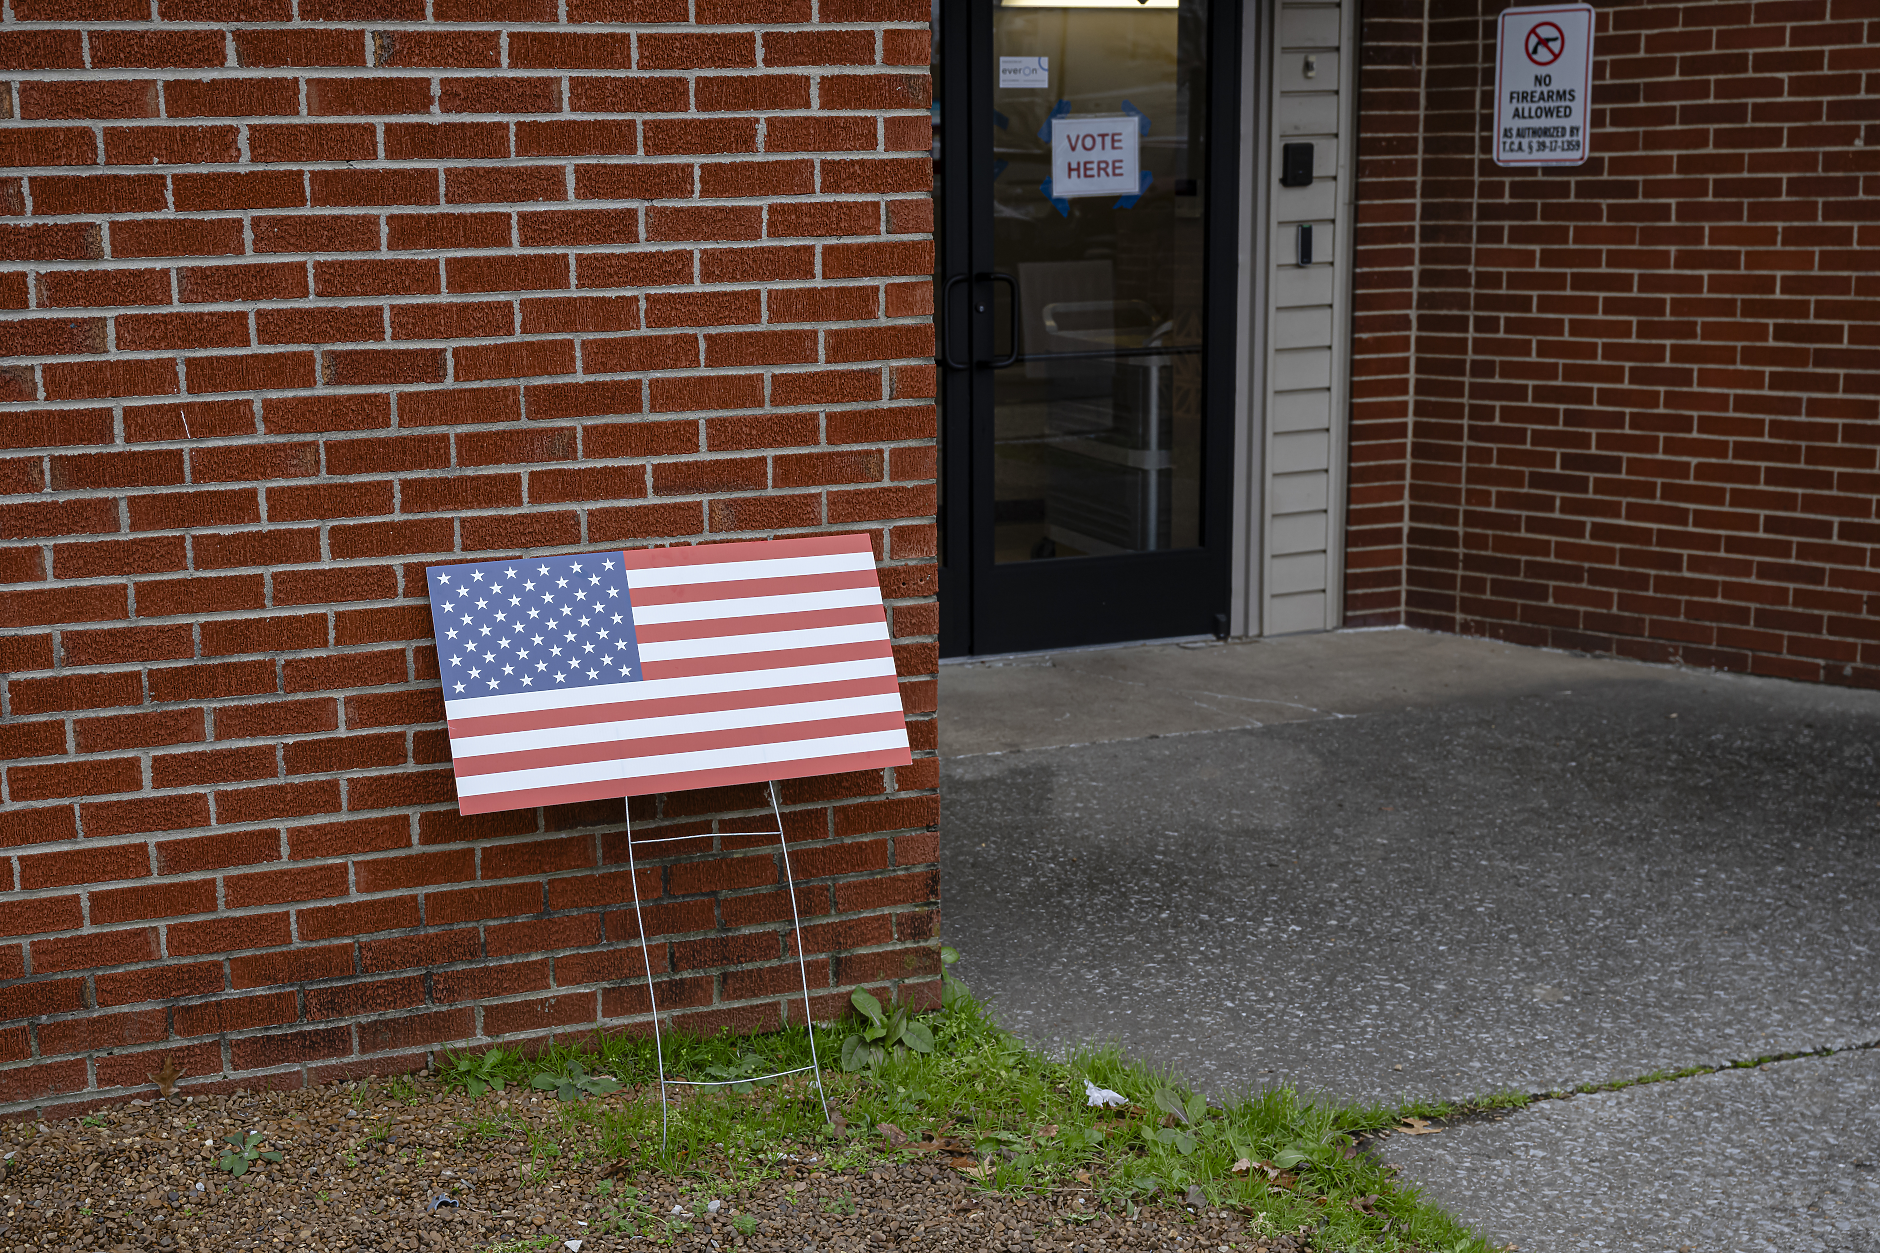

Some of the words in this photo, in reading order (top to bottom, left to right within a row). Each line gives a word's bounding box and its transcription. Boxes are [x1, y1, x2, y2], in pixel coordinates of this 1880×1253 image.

[1534, 74, 1552, 87] NO
[1509, 89, 1576, 104] FIREARMS
[1512, 105, 1572, 119] ALLOWED
[1502, 127, 1513, 139] AS
[1515, 126, 1566, 139] AUTHORIZED
[1569, 125, 1580, 138] BY
[1066, 132, 1123, 152] VOTE
[1502, 140, 1525, 153] T.C.A.
[1535, 139, 1580, 152] 39-17-1359
[1067, 159, 1124, 179] HERE
